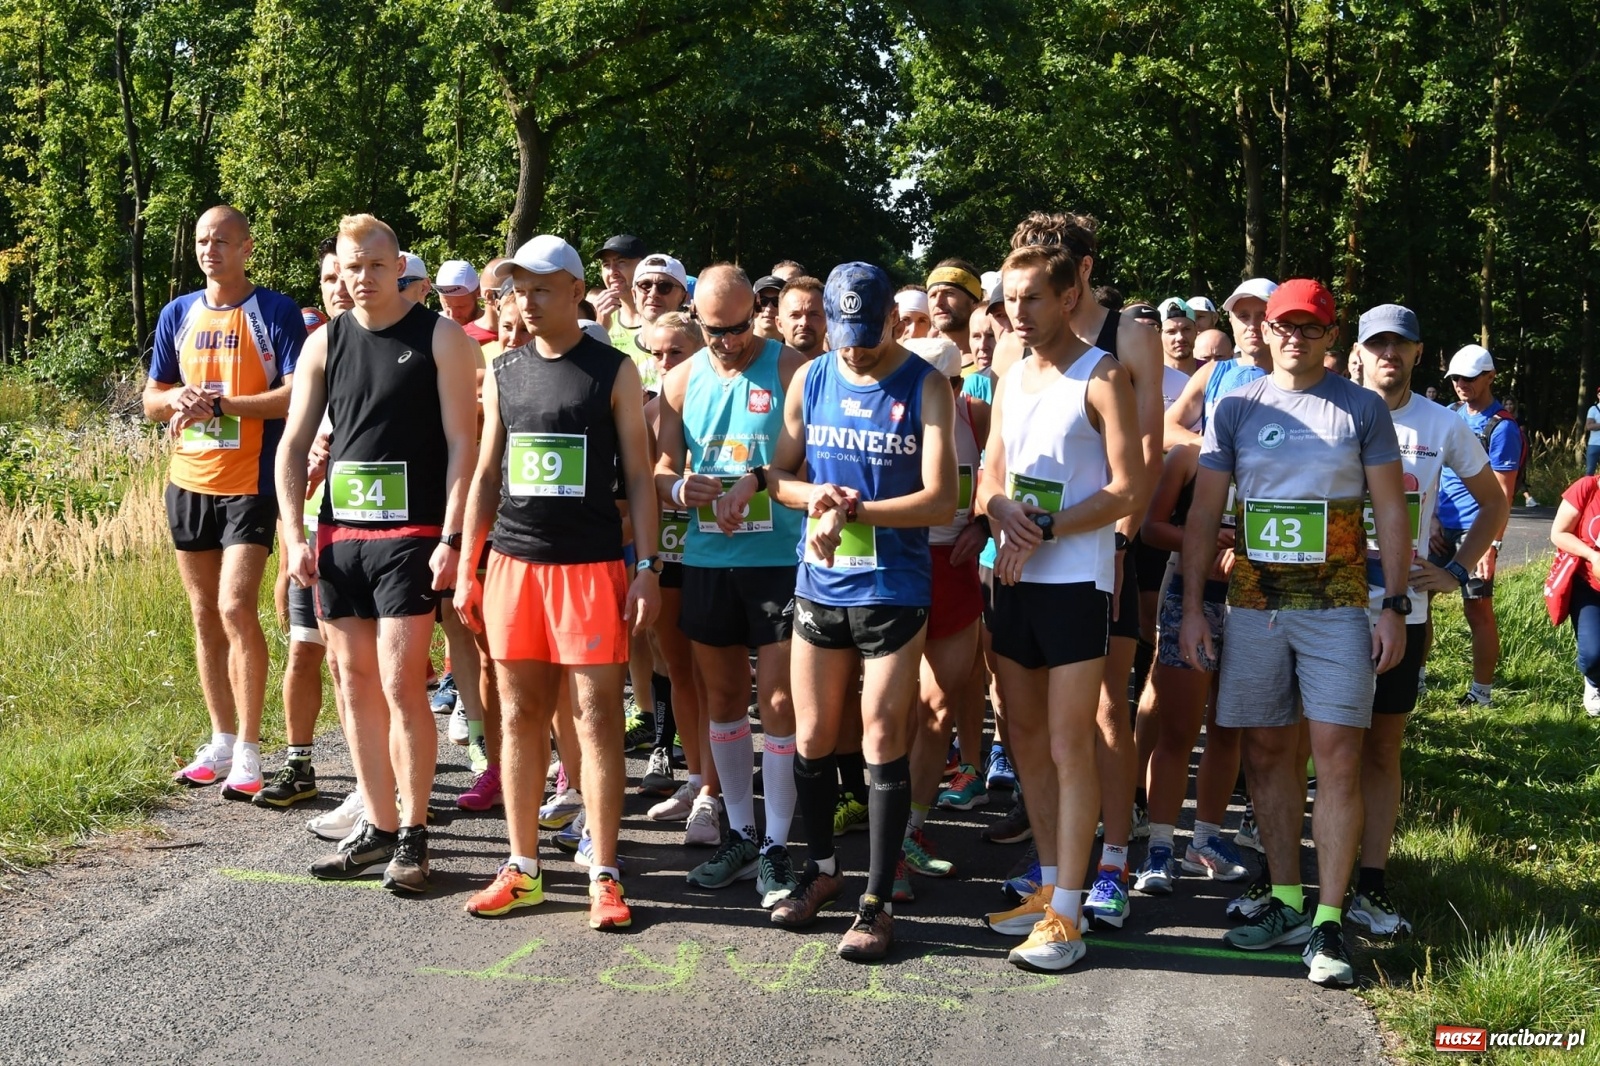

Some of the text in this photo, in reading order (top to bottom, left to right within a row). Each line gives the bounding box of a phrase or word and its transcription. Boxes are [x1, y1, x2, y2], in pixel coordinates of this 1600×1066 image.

[195, 330, 223, 350] ULC
[249, 312, 269, 353] SPARKASSE
[522, 451, 563, 482] 89
[867, 456, 893, 467] TEAM
[347, 478, 386, 507] 34
[1259, 517, 1303, 548] 43
[656, 701, 665, 723] CROSS
